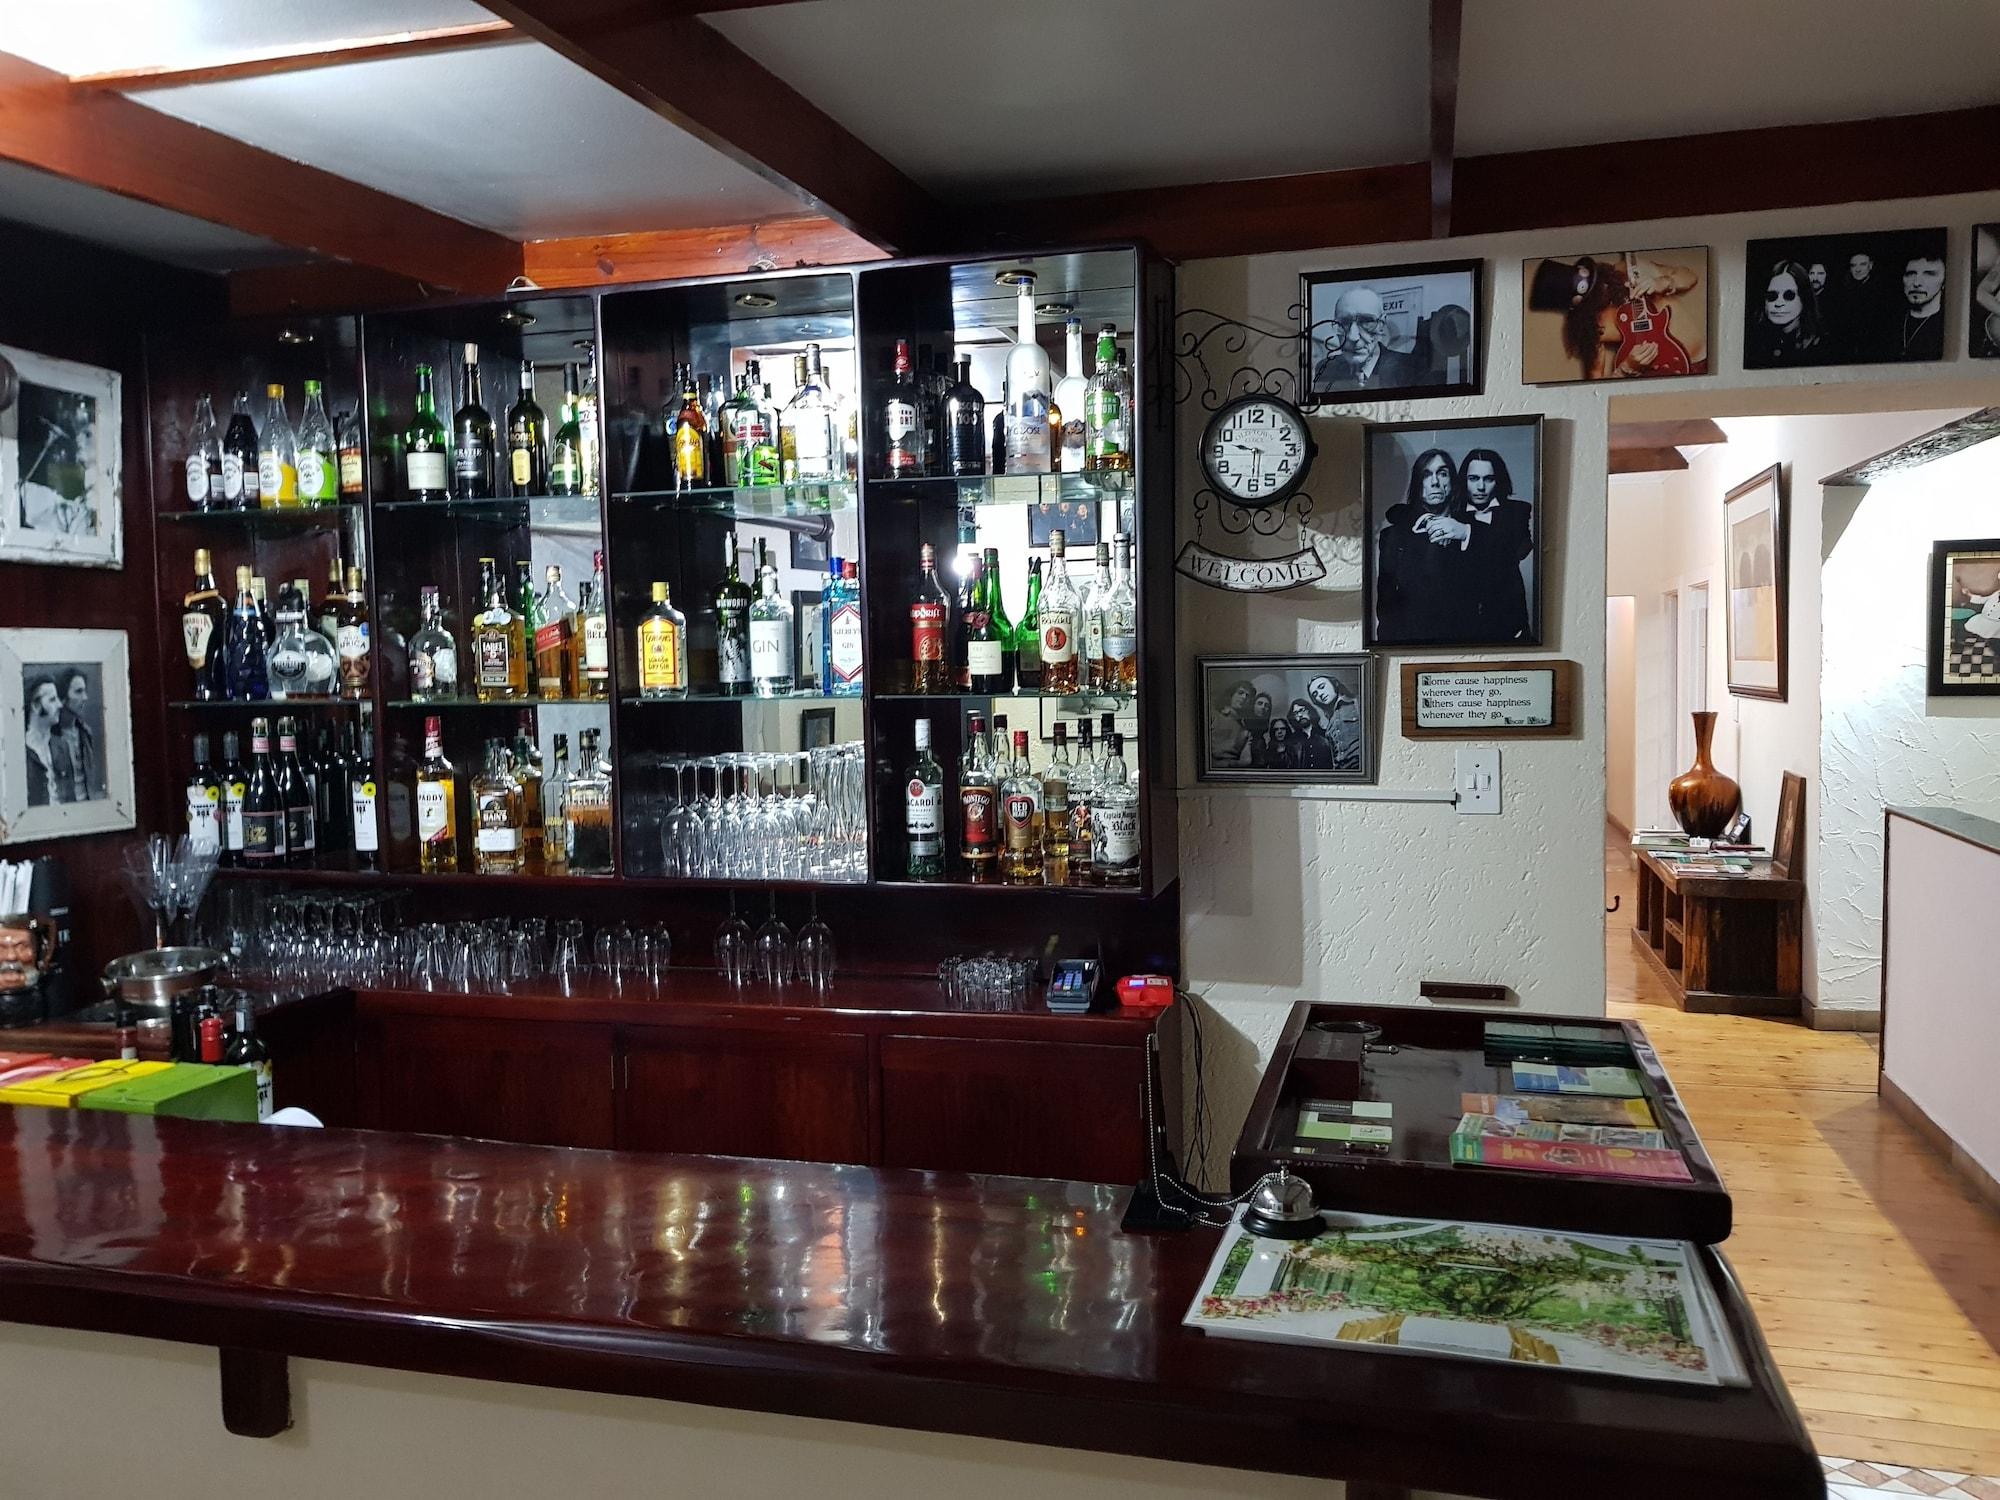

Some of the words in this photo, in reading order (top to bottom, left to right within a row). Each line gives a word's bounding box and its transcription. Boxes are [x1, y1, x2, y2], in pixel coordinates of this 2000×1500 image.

[1383, 300, 1404, 311] EXIT
[1233, 415, 1242, 428] 11
[1248, 409, 1264, 423] 12
[1271, 415, 1275, 428] 1
[1218, 429, 1232, 442] 10
[1279, 427, 1291, 441] 2
[1213, 445, 1224, 458] 9
[1285, 443, 1297, 457] 3
[1217, 460, 1229, 474] 8
[1277, 459, 1290, 473] 4
[1230, 474, 1242, 488] 7
[1247, 478, 1259, 492] 6
[1264, 473, 1276, 487] 5
[1190, 555, 1313, 584] WELCOME
[753, 639, 779, 654] GIN
[1454, 677, 1480, 685] cause
[1483, 675, 1528, 686] happiness
[1421, 688, 1462, 697] wherever
[1466, 688, 1485, 698] they
[1488, 689, 1502, 698] go.
[1457, 700, 1483, 708] cause
[1486, 698, 1532, 709] happiness
[1421, 711, 1464, 719] whenever
[1468, 710, 1487, 720] they
[1491, 712, 1504, 720] go.
[418, 794, 443, 802] PADDY
[963, 793, 991, 806] MONTEGO
[1012, 802, 1028, 811] RED
[1111, 819, 1137, 831] Black
